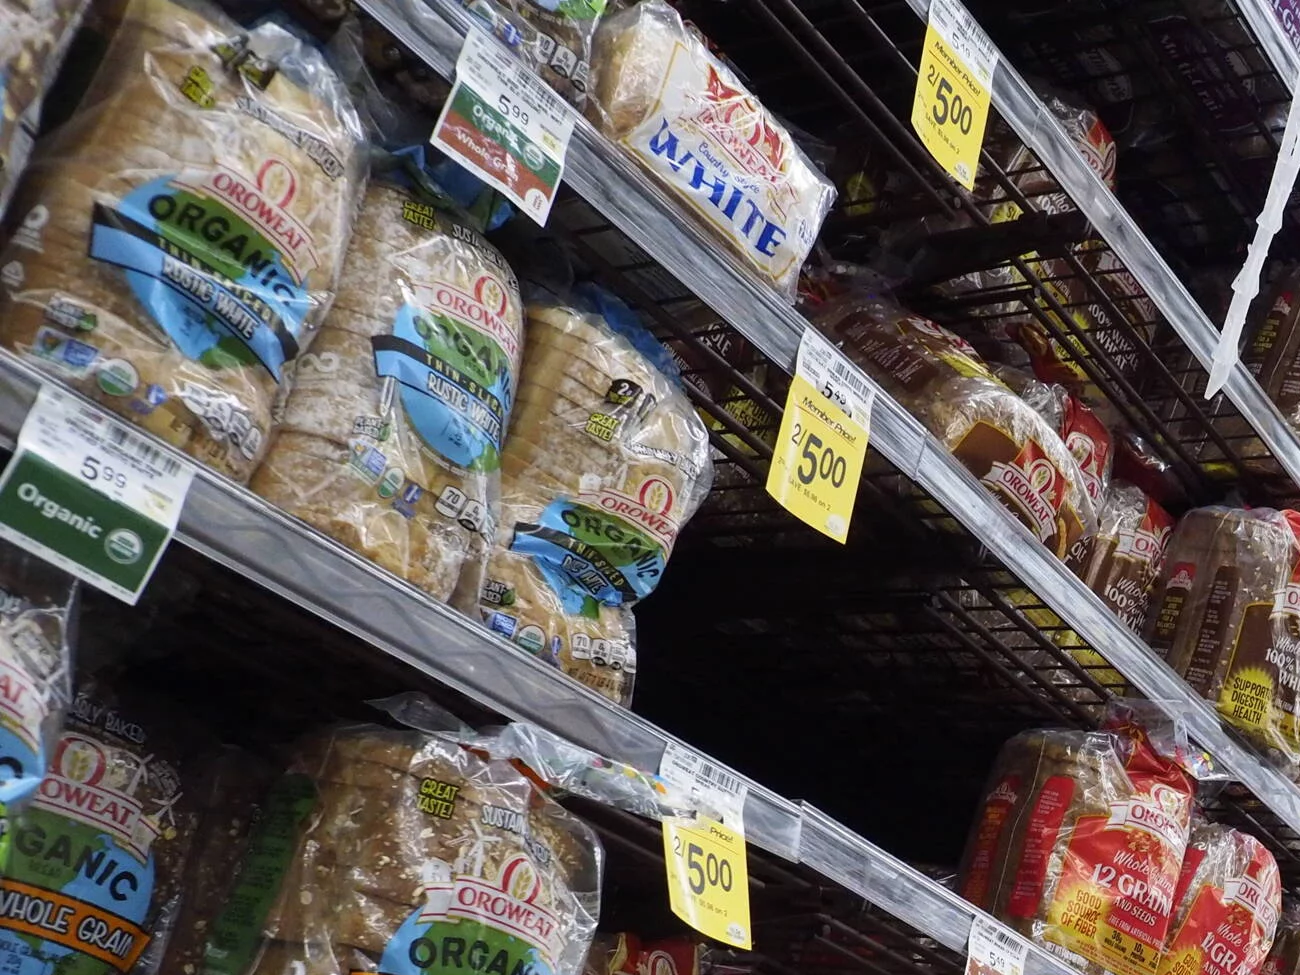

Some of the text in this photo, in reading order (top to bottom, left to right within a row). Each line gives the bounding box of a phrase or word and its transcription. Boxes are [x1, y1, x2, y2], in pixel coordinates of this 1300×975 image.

[649, 115, 787, 258] WHITE
[212, 173, 306, 249] OROWEAT
[148, 194, 296, 307] ORGANIC
[437, 290, 517, 356] OROWEAT
[427, 373, 469, 411] RUSTIC
[17, 482, 104, 540] Organic
[1002, 468, 1051, 522] OROWEAT
[1232, 705, 1262, 725] HEALTH
[416, 793, 455, 821] TASTE!
[420, 778, 460, 802] GREAT
[1092, 862, 1117, 888] 12
[458, 886, 556, 941] OROWEAT
[1066, 900, 1101, 923] SOURCE
[1076, 889, 1101, 910] GOOD
[1113, 896, 1158, 928] AND SEEDS
[1060, 911, 1098, 939] OF FIBER
